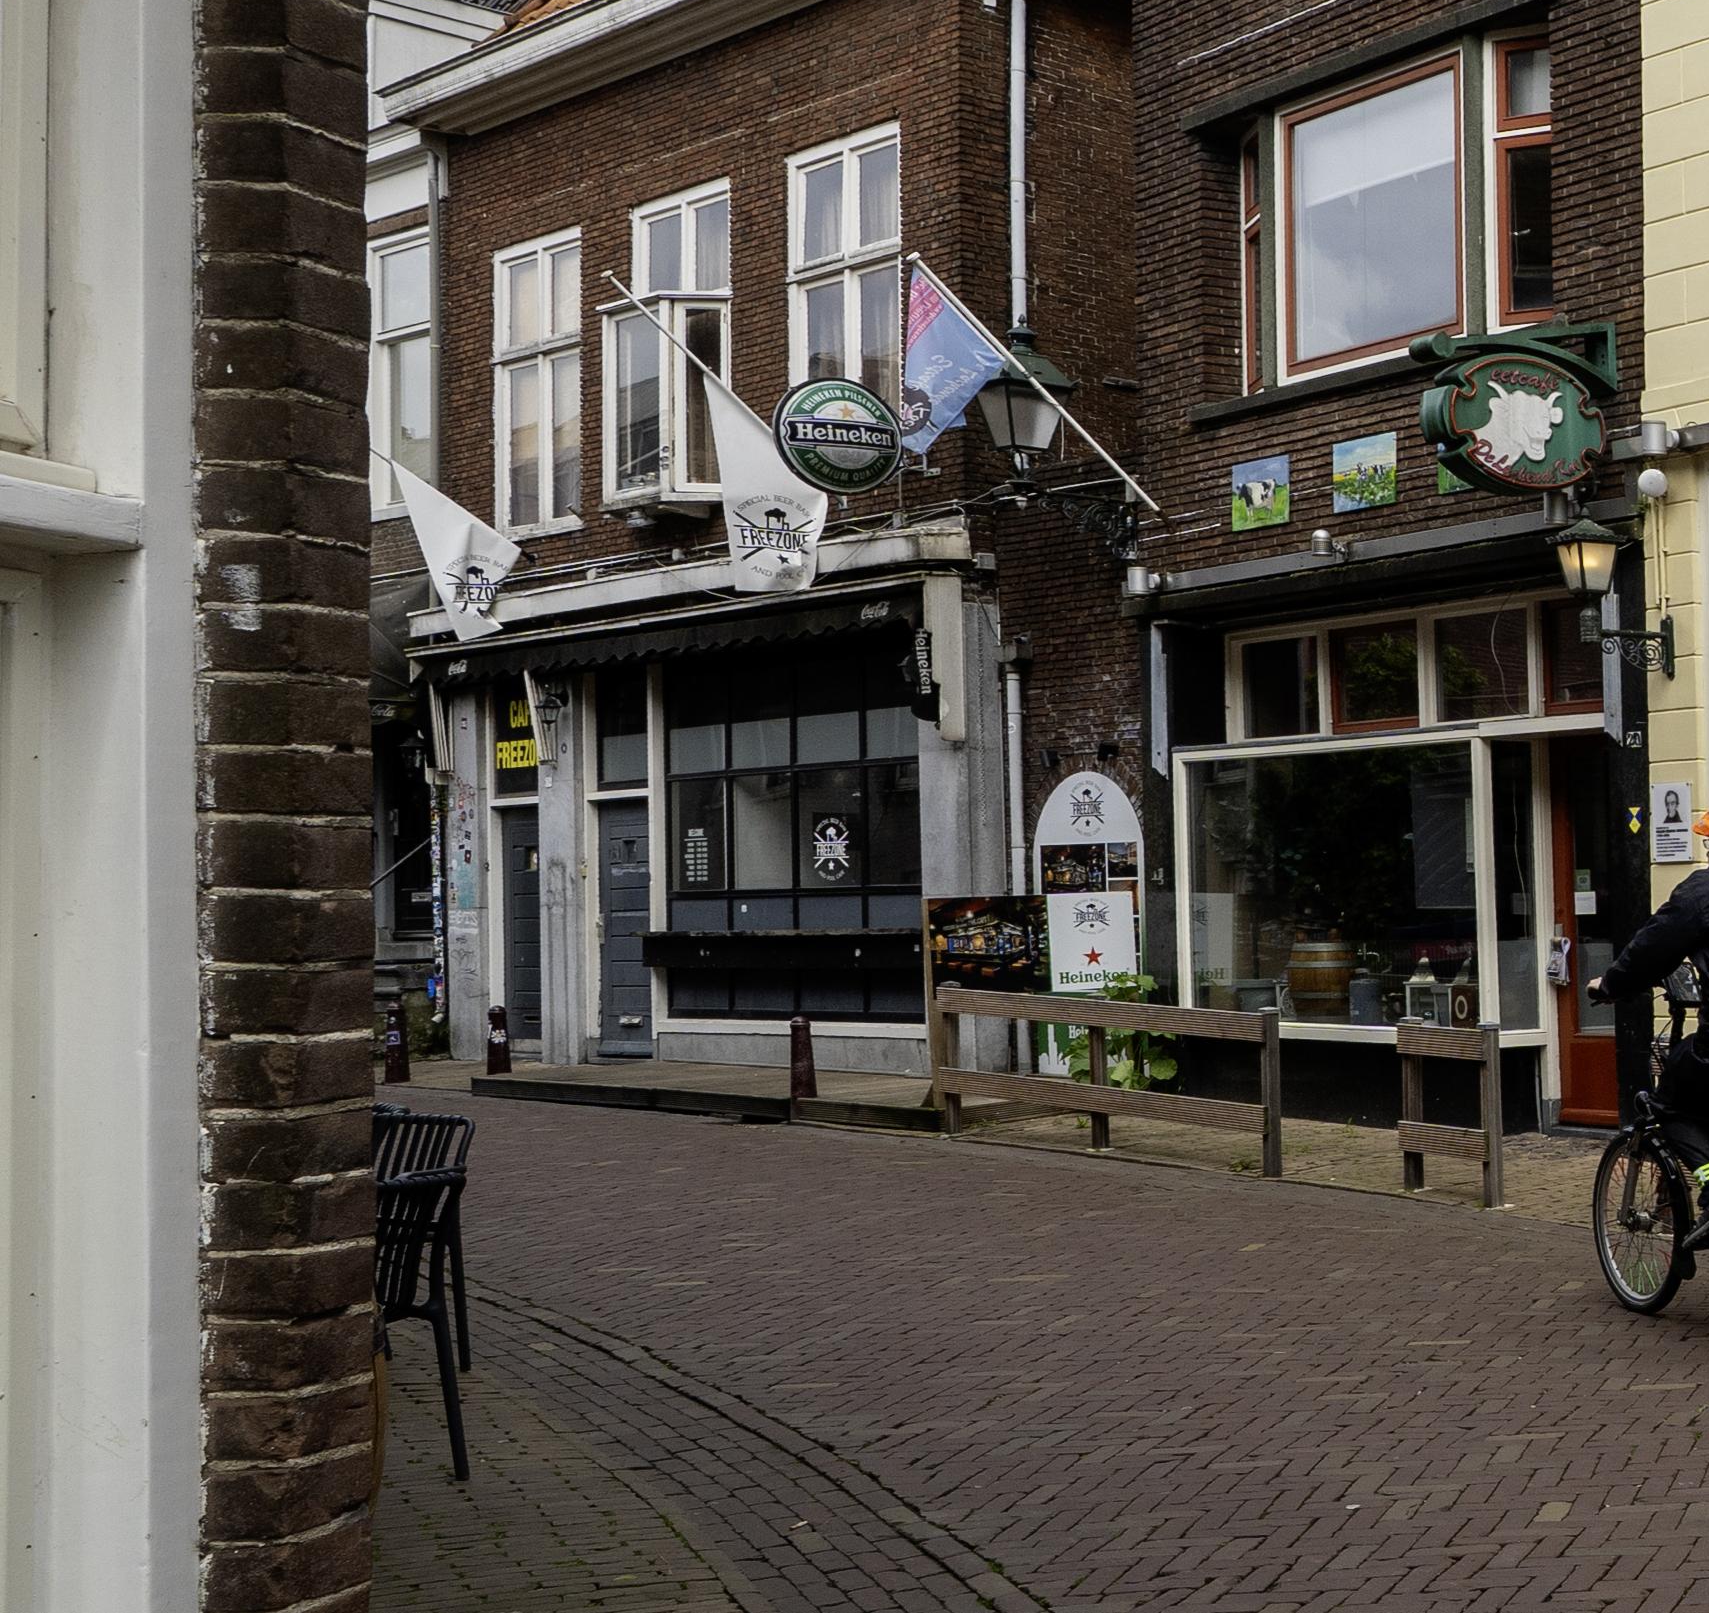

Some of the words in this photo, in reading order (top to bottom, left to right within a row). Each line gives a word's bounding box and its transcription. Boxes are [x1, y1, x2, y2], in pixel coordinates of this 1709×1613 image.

[801, 389, 843, 412] HEINEKEN
[844, 390, 881, 418] PILSENER
[795, 423, 892, 447] Heineken
[804, 452, 849, 481] PREMIUM
[853, 458, 886, 481] QUALITY
[737, 495, 771, 512] SPECIAL
[774, 495, 796, 507] BEER
[740, 529, 810, 550] FREEZONE
[915, 628, 932, 694] Heineken
[496, 739, 539, 769] FREEZO
